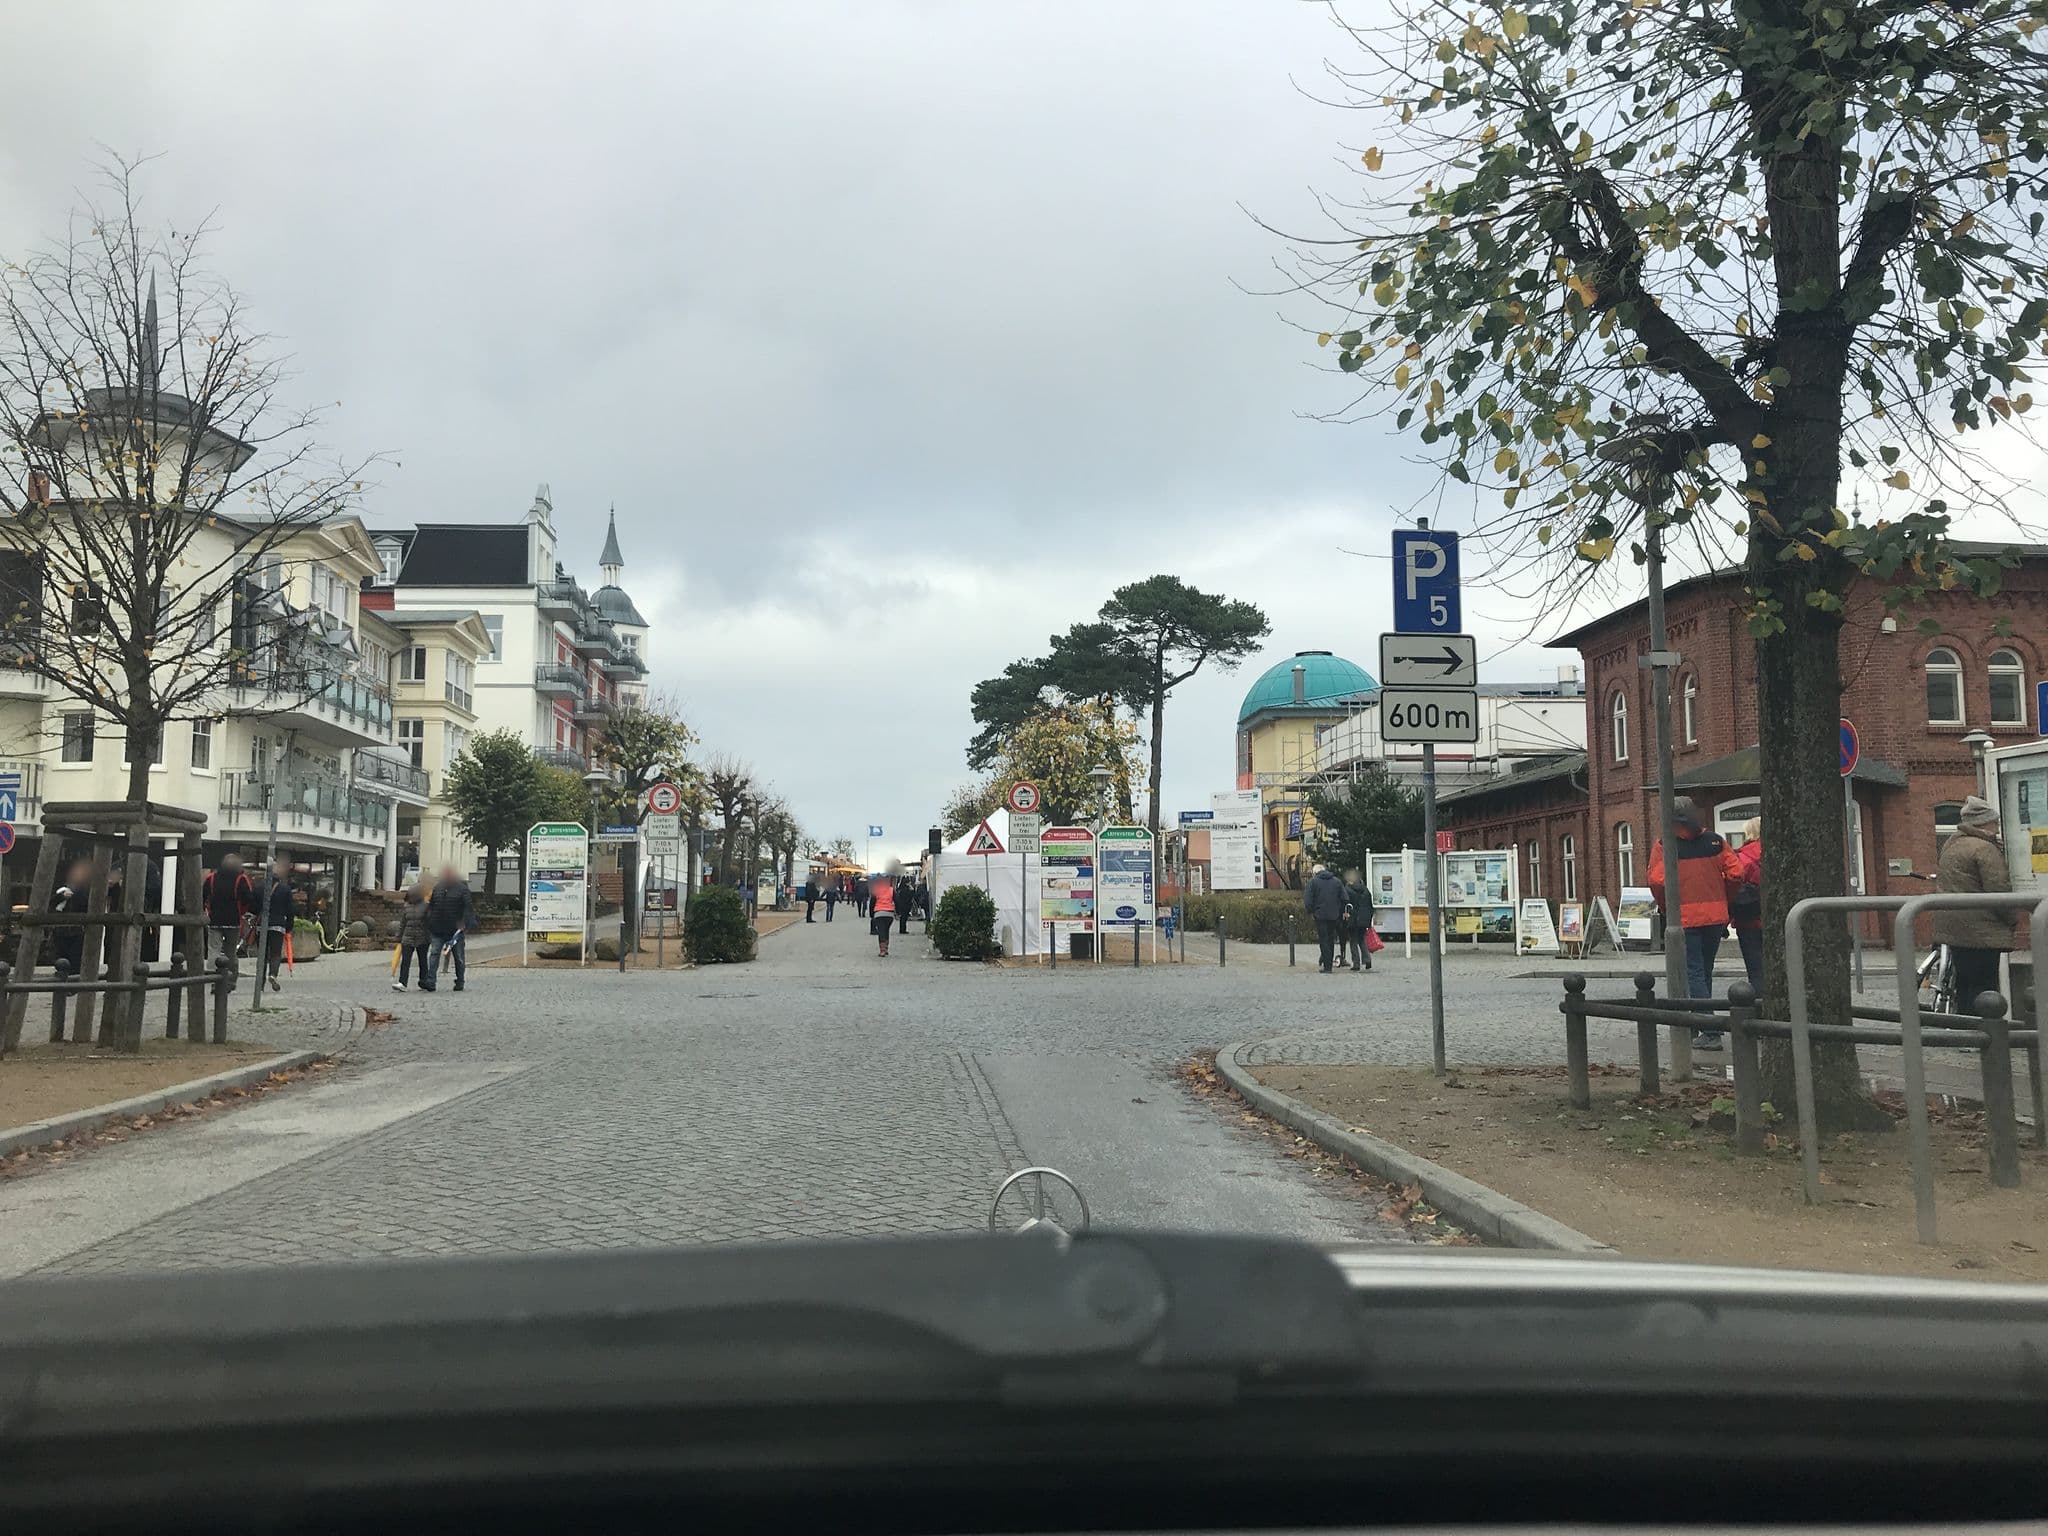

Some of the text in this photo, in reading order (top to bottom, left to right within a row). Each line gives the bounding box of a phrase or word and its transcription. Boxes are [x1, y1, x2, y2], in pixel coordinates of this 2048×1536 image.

[1405, 540, 1447, 600] P
[1430, 596, 1448, 627] 5
[1389, 703, 1470, 729] 600 m
